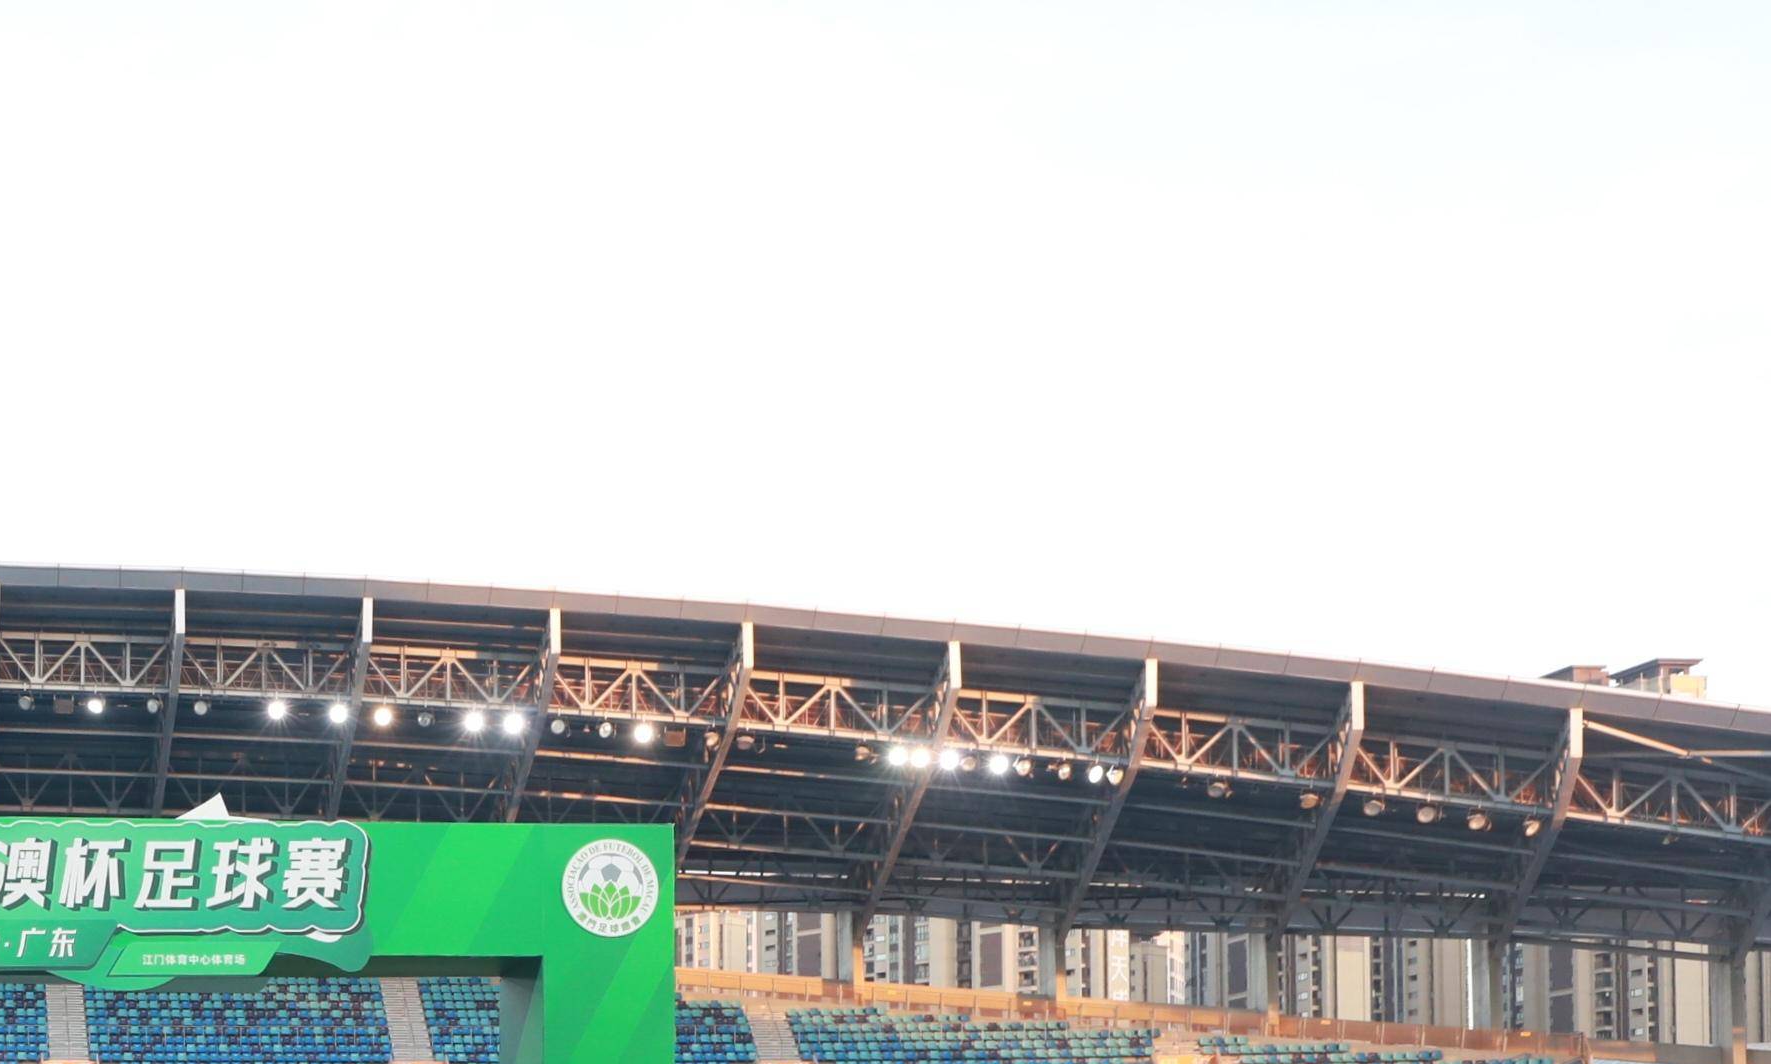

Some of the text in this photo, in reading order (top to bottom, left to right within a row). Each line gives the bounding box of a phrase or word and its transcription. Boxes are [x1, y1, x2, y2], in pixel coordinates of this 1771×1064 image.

[142, 954, 246, 966] 江门体育中心体育场
